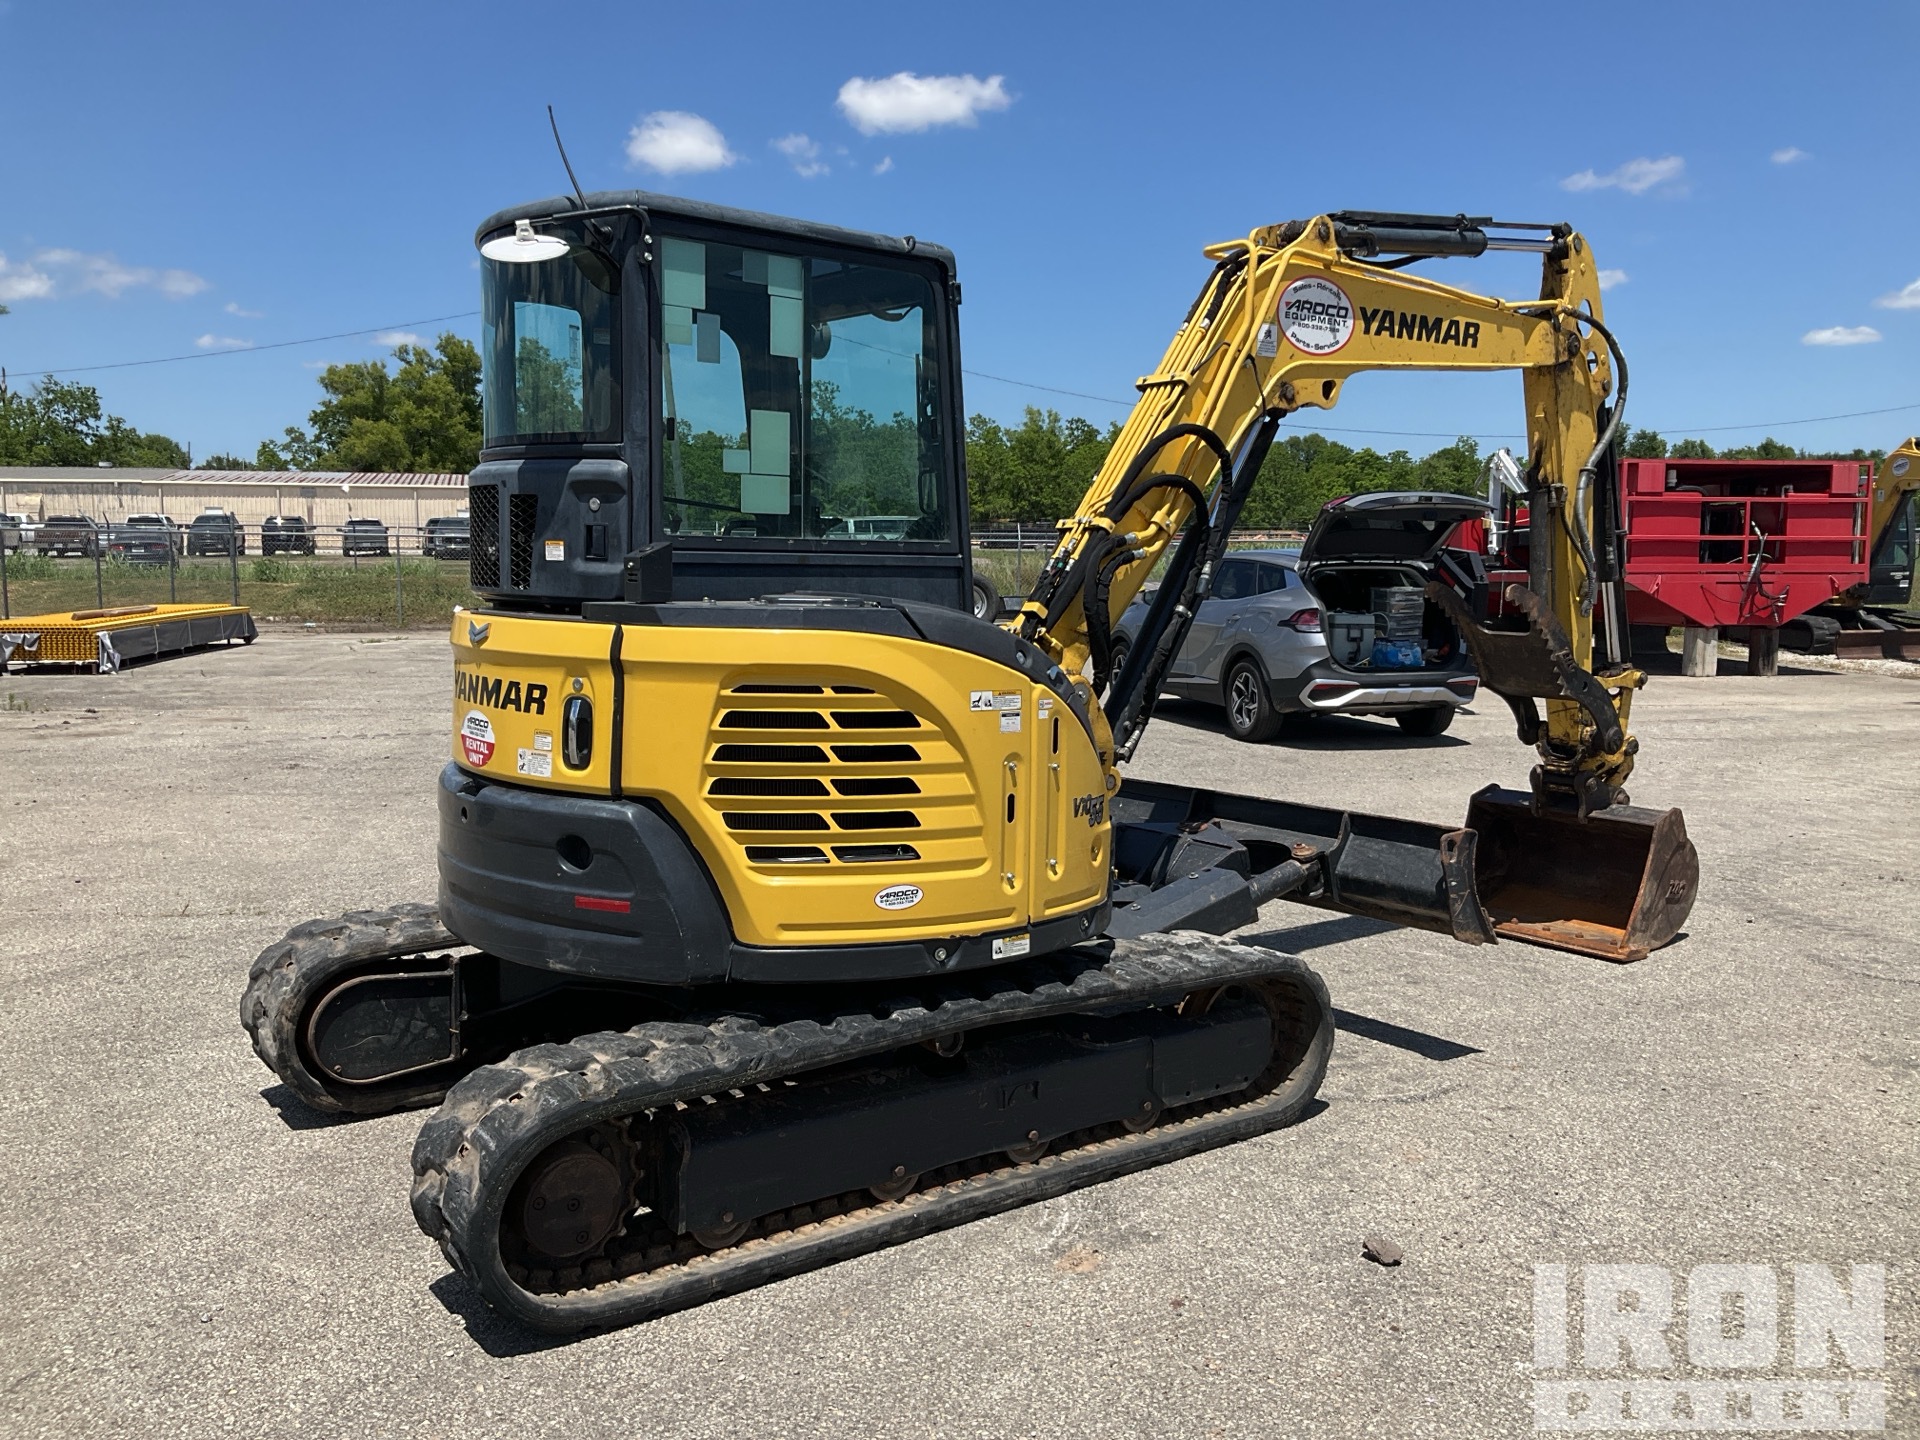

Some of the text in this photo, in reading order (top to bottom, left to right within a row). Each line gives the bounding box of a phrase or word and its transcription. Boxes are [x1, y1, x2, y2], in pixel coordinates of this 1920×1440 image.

[1292, 282, 1342, 302] Sales Rentals
[1285, 311, 1348, 327] EQUIPMENT
[1286, 299, 1349, 319] ARDCO
[1359, 306, 1480, 348] YANMAR
[1290, 331, 1311, 348] Parts
[1314, 339, 1340, 351] Service
[454, 669, 548, 715] YANMAR
[465, 737, 489, 753] RENTAL
[468, 752, 484, 765] UNIT
[879, 889, 919, 899] ARDCO
